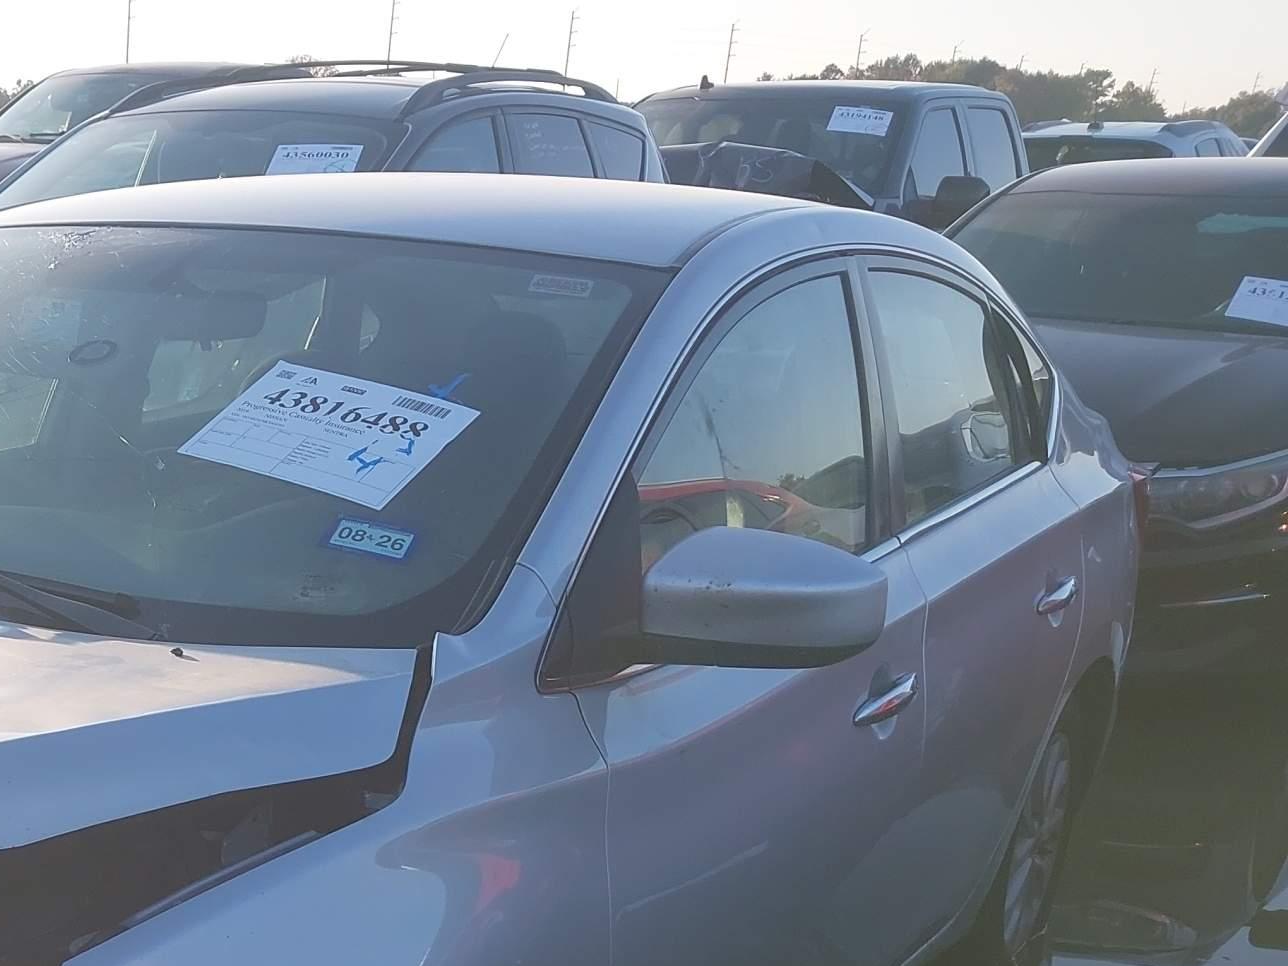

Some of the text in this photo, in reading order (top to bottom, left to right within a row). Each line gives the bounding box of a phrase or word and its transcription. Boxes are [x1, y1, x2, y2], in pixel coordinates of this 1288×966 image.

[241, 400, 288, 416] Progressive
[289, 411, 322, 424] Casualty
[325, 419, 366, 436] Insurance
[263, 388, 429, 440] 43816488
[338, 526, 406, 551] 08 26
